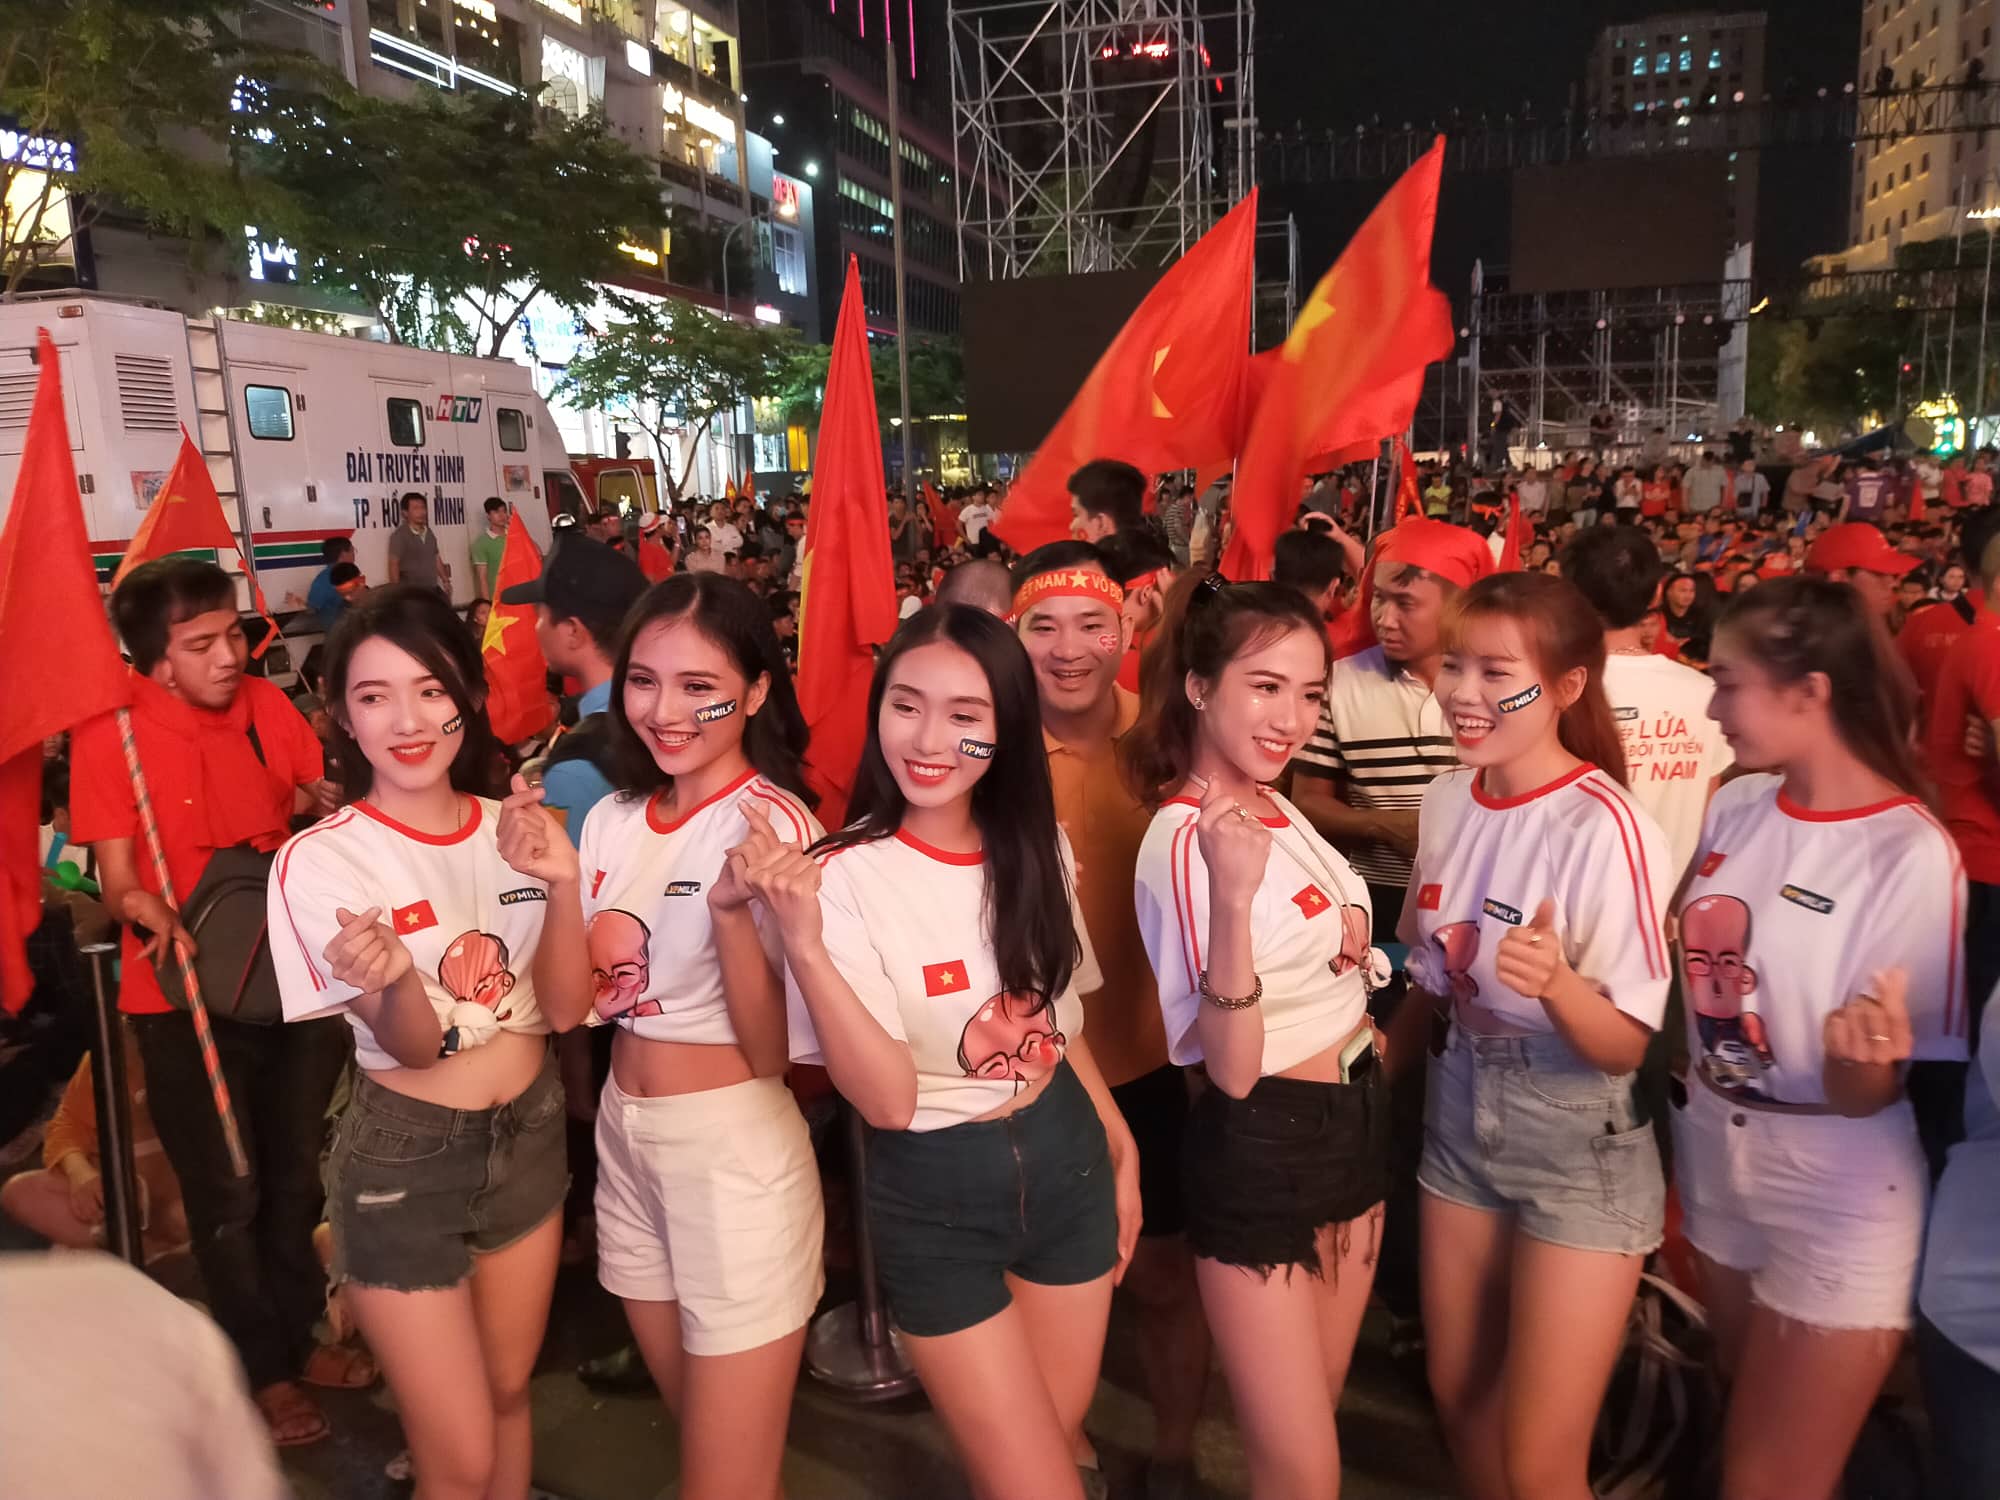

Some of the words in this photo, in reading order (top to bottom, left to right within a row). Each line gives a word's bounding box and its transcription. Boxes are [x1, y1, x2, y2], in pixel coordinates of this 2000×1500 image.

[437, 396, 481, 422] HTV
[346, 446, 372, 483] ĐÀI
[434, 448, 465, 483] HÌNH
[433, 496, 465, 526] MINH
[1034, 573, 1068, 592] NAM
[1091, 573, 1109, 593] VÔ
[697, 701, 736, 721] VPMILK
[1500, 685, 1540, 711] VPMILK
[1639, 710, 1688, 739] LỬA
[1650, 760, 1698, 782] NAM
[500, 889, 545, 903] VPMILK
